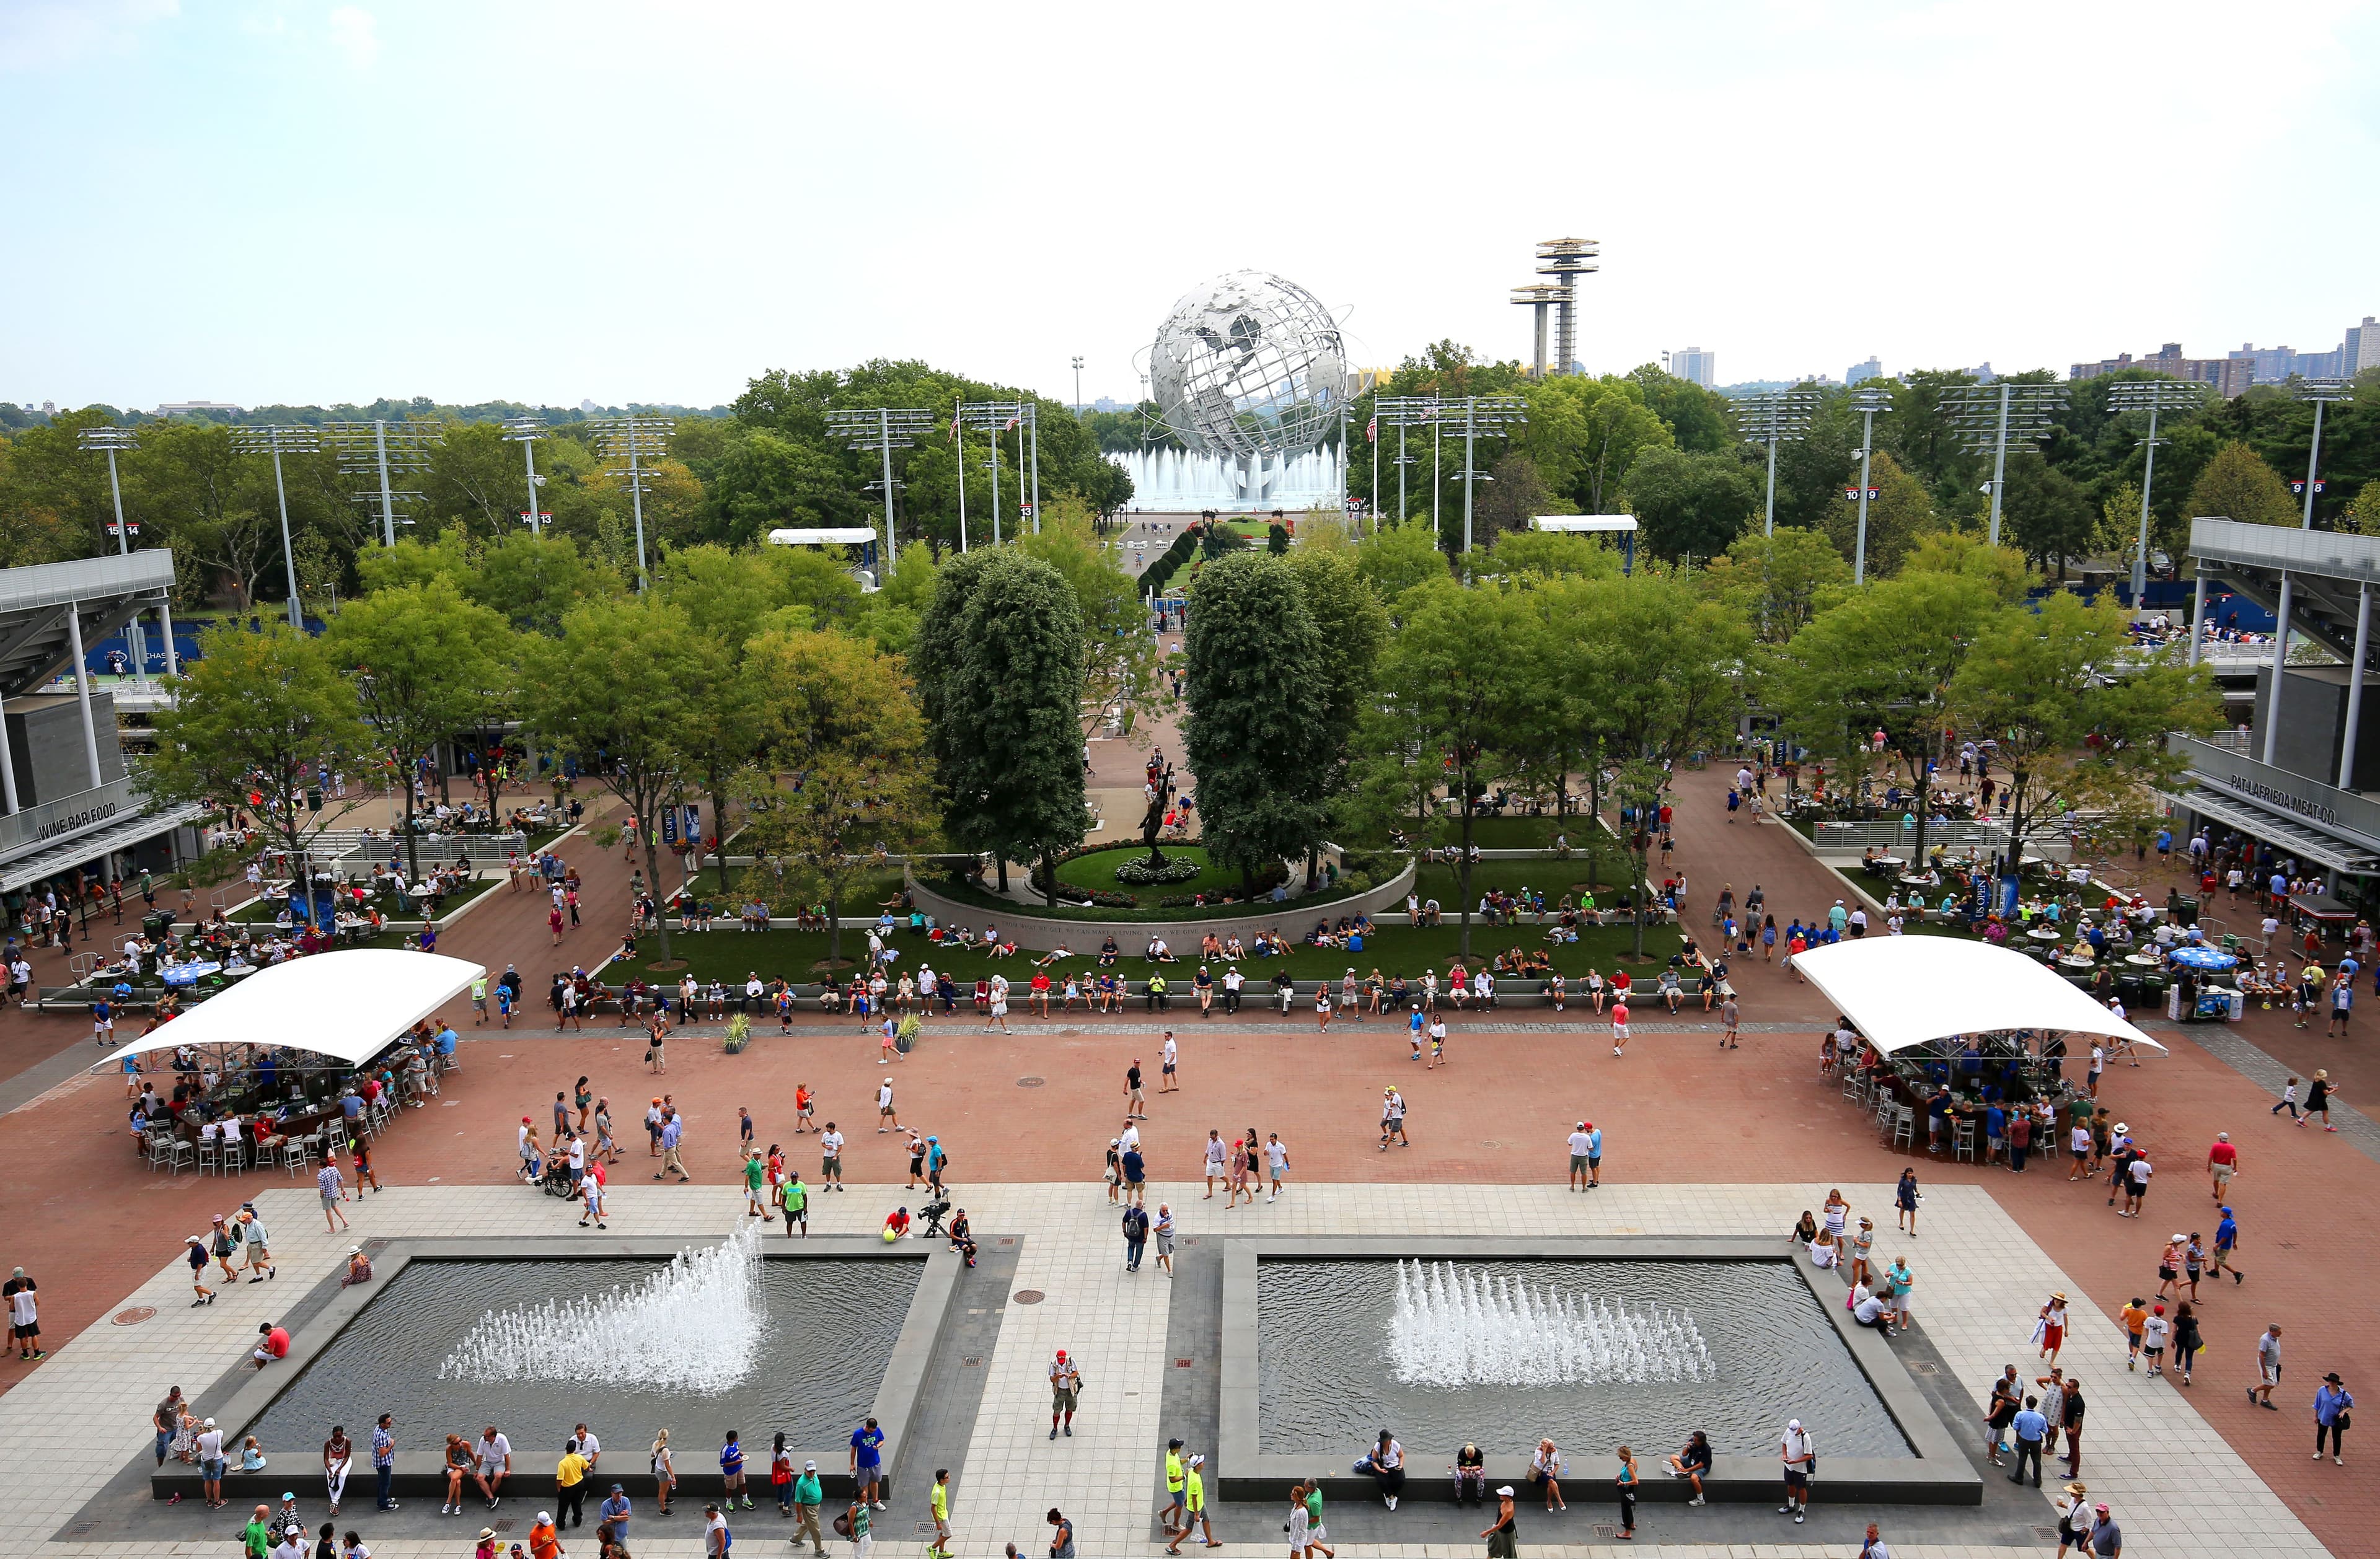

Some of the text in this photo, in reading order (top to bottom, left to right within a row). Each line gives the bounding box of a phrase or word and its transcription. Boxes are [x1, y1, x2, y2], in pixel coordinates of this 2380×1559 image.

[2294, 484, 2301, 493] 9
[2314, 483, 2322, 493] 8
[1846, 491, 1858, 499] 10
[1869, 491, 1876, 499] 9
[1348, 502, 1360, 511] 10
[1020, 507, 1032, 516] 13
[521, 515, 532, 524] 14
[540, 515, 552, 524] 13
[108, 527, 119, 535] 15
[127, 527, 139, 535] 14
[2232, 775, 2247, 793] PAT
[2248, 781, 2291, 810] LAFRIEDA
[2293, 796, 2320, 820] MEAT
[37, 802, 117, 840] WINE BAR FOOD
[666, 830, 674, 840] US
[1975, 880, 1986, 917] US OPEN
